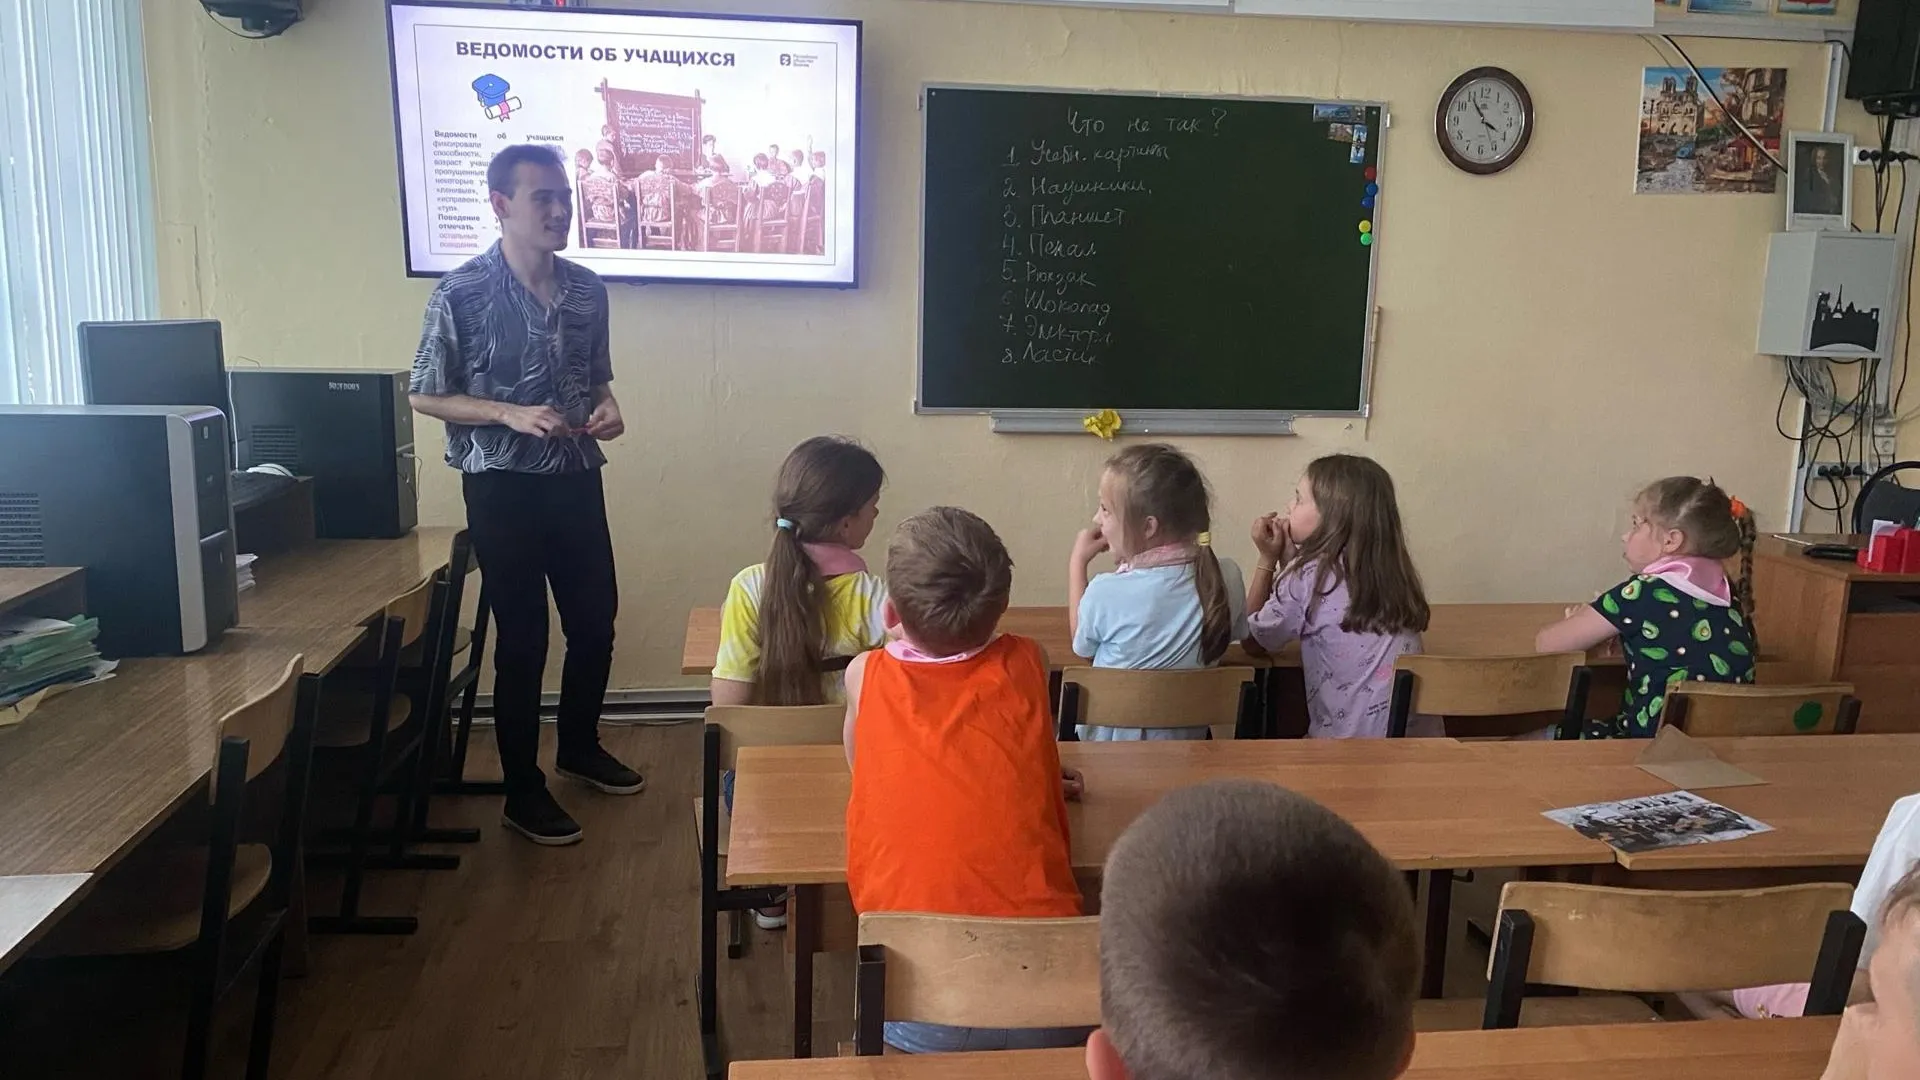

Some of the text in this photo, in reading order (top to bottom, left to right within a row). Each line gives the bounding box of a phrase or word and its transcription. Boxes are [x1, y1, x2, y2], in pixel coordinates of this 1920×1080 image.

[456, 41, 736, 68] ВЕДОМОСТИ ОБ УЧАЩИХСЯ
[1067, 106, 1105, 137] Что
[1127, 117, 1151, 133] не
[434, 130, 565, 142] Ведомости об учащихся
[433, 159, 462, 167] возраст
[438, 213, 481, 222] Поведение
[438, 222, 475, 231] отмечать
[1031, 204, 1126, 228] Планшет
[1029, 233, 1097, 258] Пенал
[1025, 261, 1097, 296] Рюкзак
[1024, 287, 1112, 327] Шоколад
